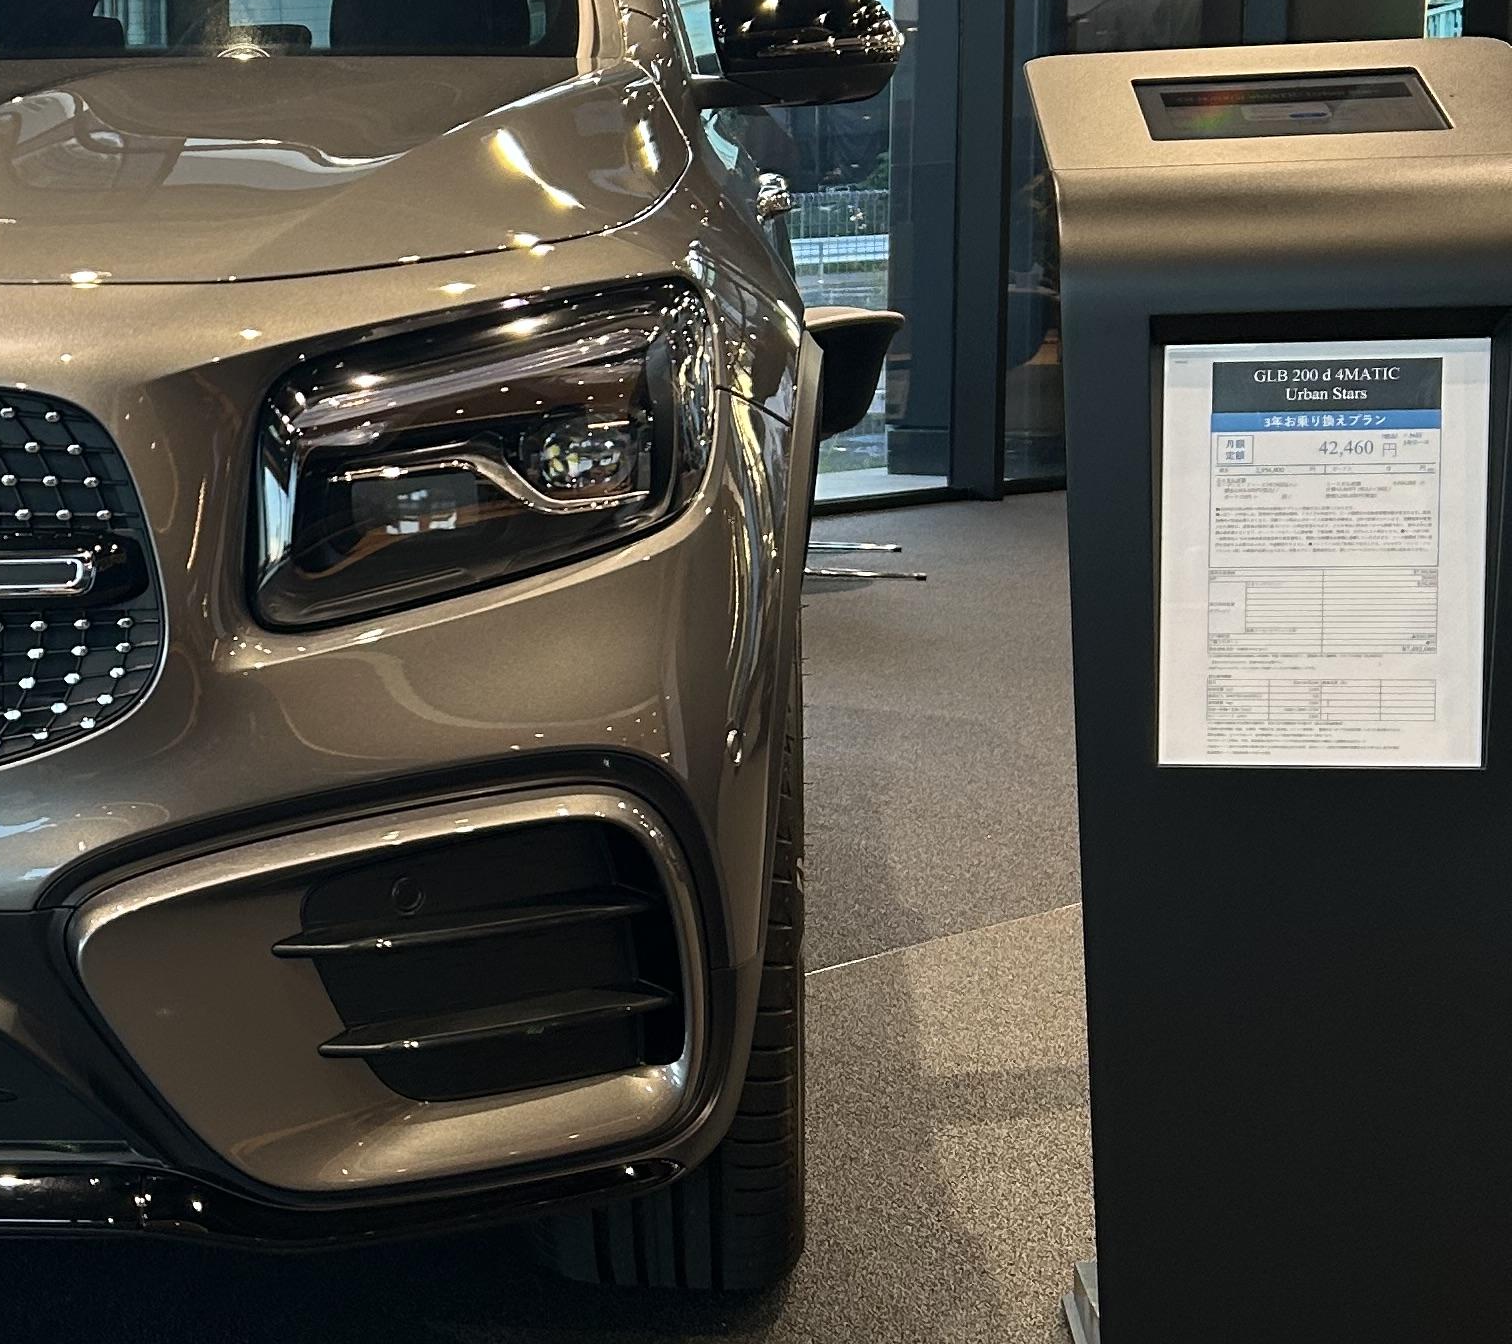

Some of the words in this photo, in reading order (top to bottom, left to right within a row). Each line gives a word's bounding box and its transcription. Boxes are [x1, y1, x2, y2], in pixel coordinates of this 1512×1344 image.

[1254, 369, 1288, 383] GLB
[1292, 368, 1319, 382] 200
[1322, 368, 1332, 381] d
[1335, 366, 1401, 381] 4MATIC
[1285, 387, 1328, 401] Urban
[1332, 386, 1368, 400] Stars
[1263, 414, 1387, 428] 3年お乗り換えプラン
[1318, 440, 1374, 458] 42,460
